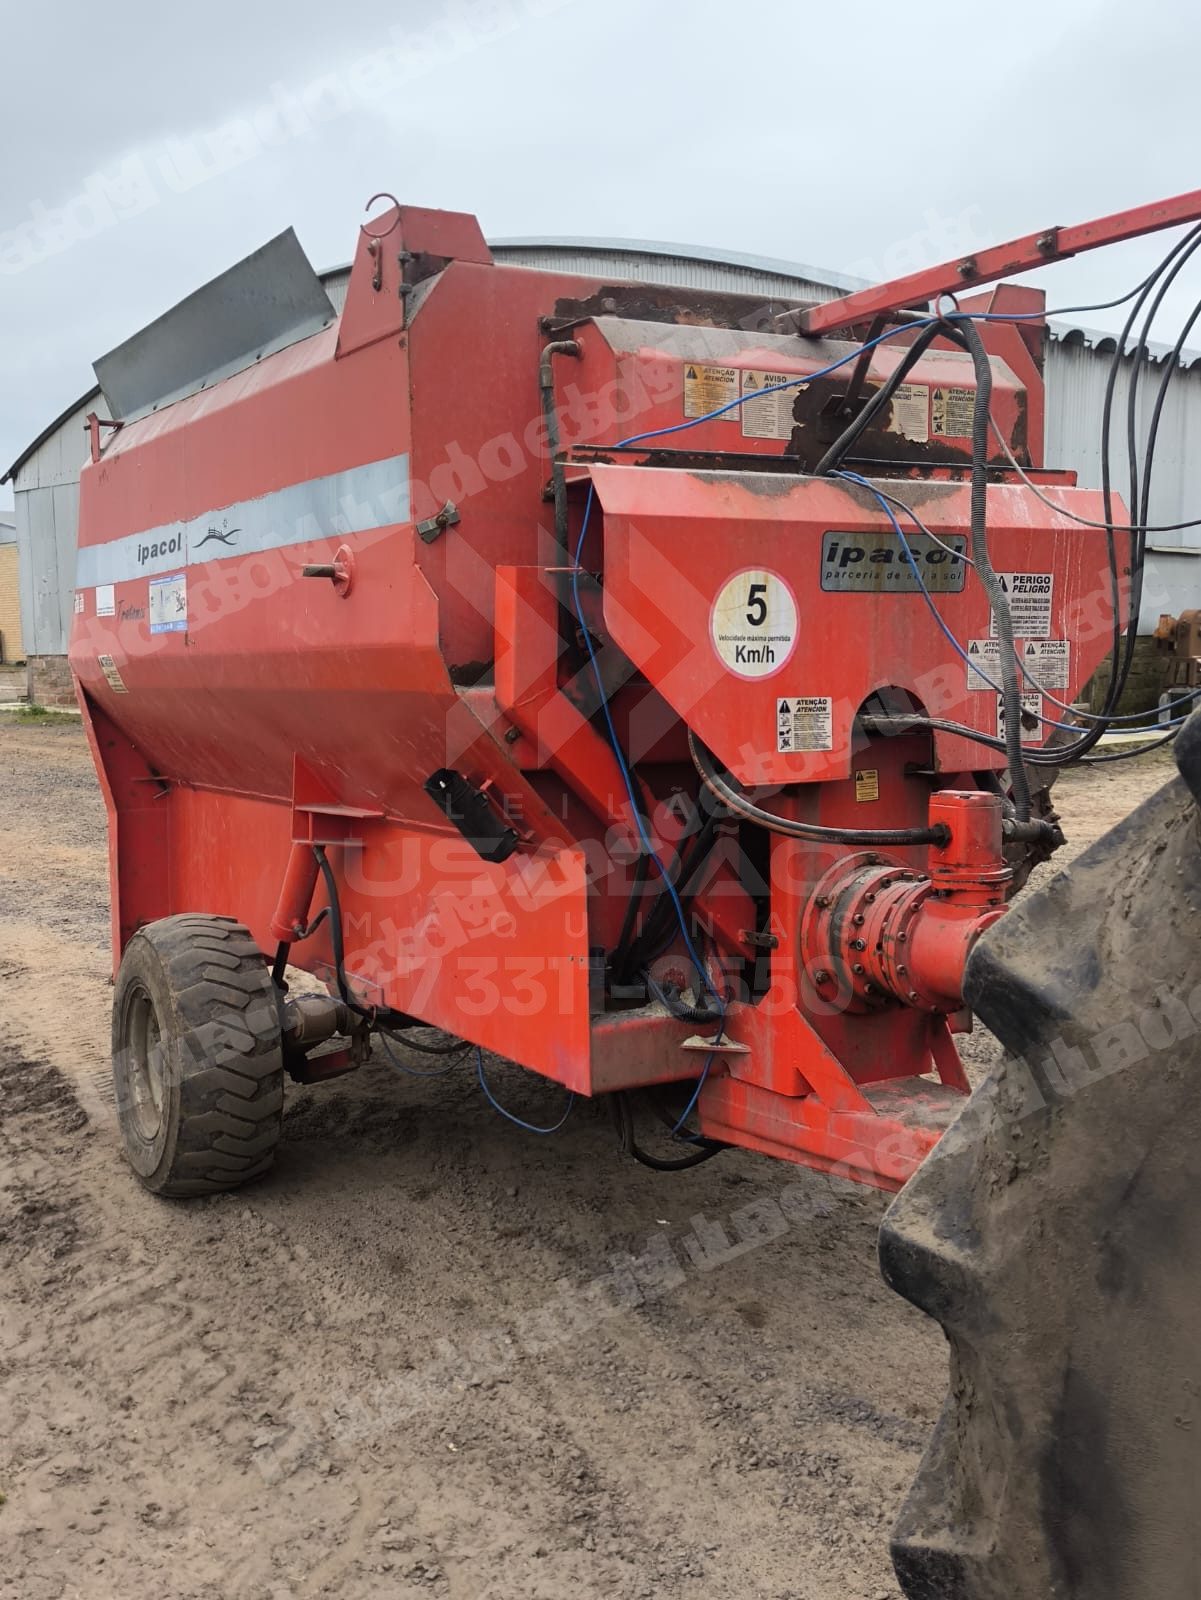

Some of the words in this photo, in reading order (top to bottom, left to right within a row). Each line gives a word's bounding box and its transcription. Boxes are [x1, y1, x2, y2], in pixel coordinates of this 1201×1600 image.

[703, 367, 735, 376] ATENÇÃO
[764, 374, 787, 383] AVISO
[138, 532, 181, 565] ipacol
[826, 543, 963, 567] ipacol
[825, 570, 880, 580] parceria
[886, 571, 900, 580] de
[943, 571, 961, 580] sol
[1013, 576, 1051, 584] PERIGO
[1012, 585, 1050, 593] PELIGRO
[746, 584, 767, 626] 5
[735, 645, 775, 663] Km/h
[796, 698, 827, 706] ATENÇÃO
